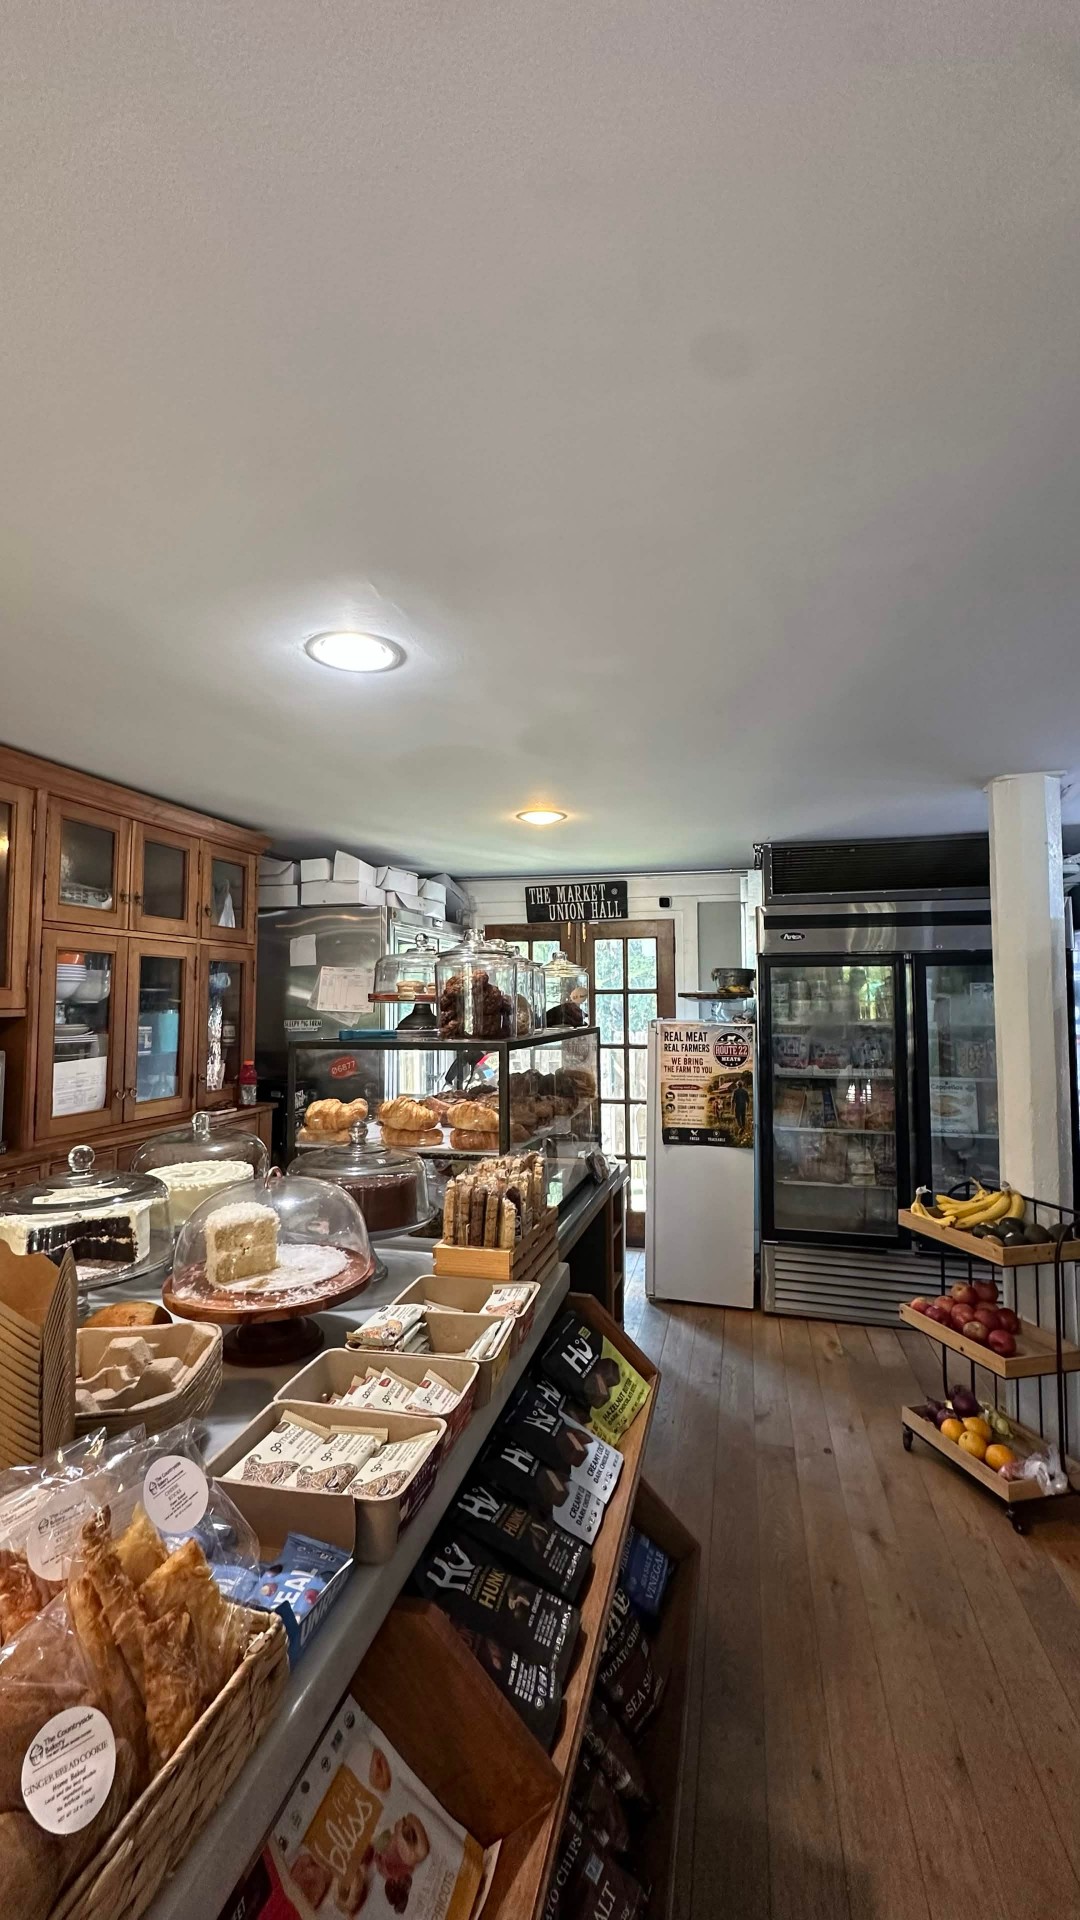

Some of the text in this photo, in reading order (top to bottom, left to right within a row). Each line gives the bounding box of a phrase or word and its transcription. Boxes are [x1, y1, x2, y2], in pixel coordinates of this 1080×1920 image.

[529, 884, 606, 904] THE MARKET
[549, 901, 622, 921] UNION HALL
[664, 1031, 708, 1042] REAL MEAT
[664, 1043, 710, 1053] REAL FARMERS
[671, 1057, 704, 1066] WE BRING
[715, 1045, 748, 1055] ROUTE 22
[664, 1065, 674, 1073] THE
[701, 1066, 713, 1074] YOU
[601, 1377, 634, 1421] HAZELNUT BUTTER
[607, 1411, 619, 1425] DARK
[617, 1390, 634, 1413] CHOCOLATE
[270, 1425, 300, 1454] gomacro
[586, 1452, 601, 1477] CREAMY
[592, 1468, 602, 1483] DARK
[568, 1491, 583, 1519] CREAMY
[575, 1506, 586, 1526] DARK
[644, 1550, 664, 1599] VINEGAR
[622, 1688, 647, 1719] SEA
[43, 1712, 94, 1746] The Countryside
[44, 1739, 66, 1754] Bakery
[23, 1739, 108, 1797] GINGER BREAD COOKIE
[311, 1795, 373, 1875] bliss
[554, 1832, 583, 1887] CHIPS
